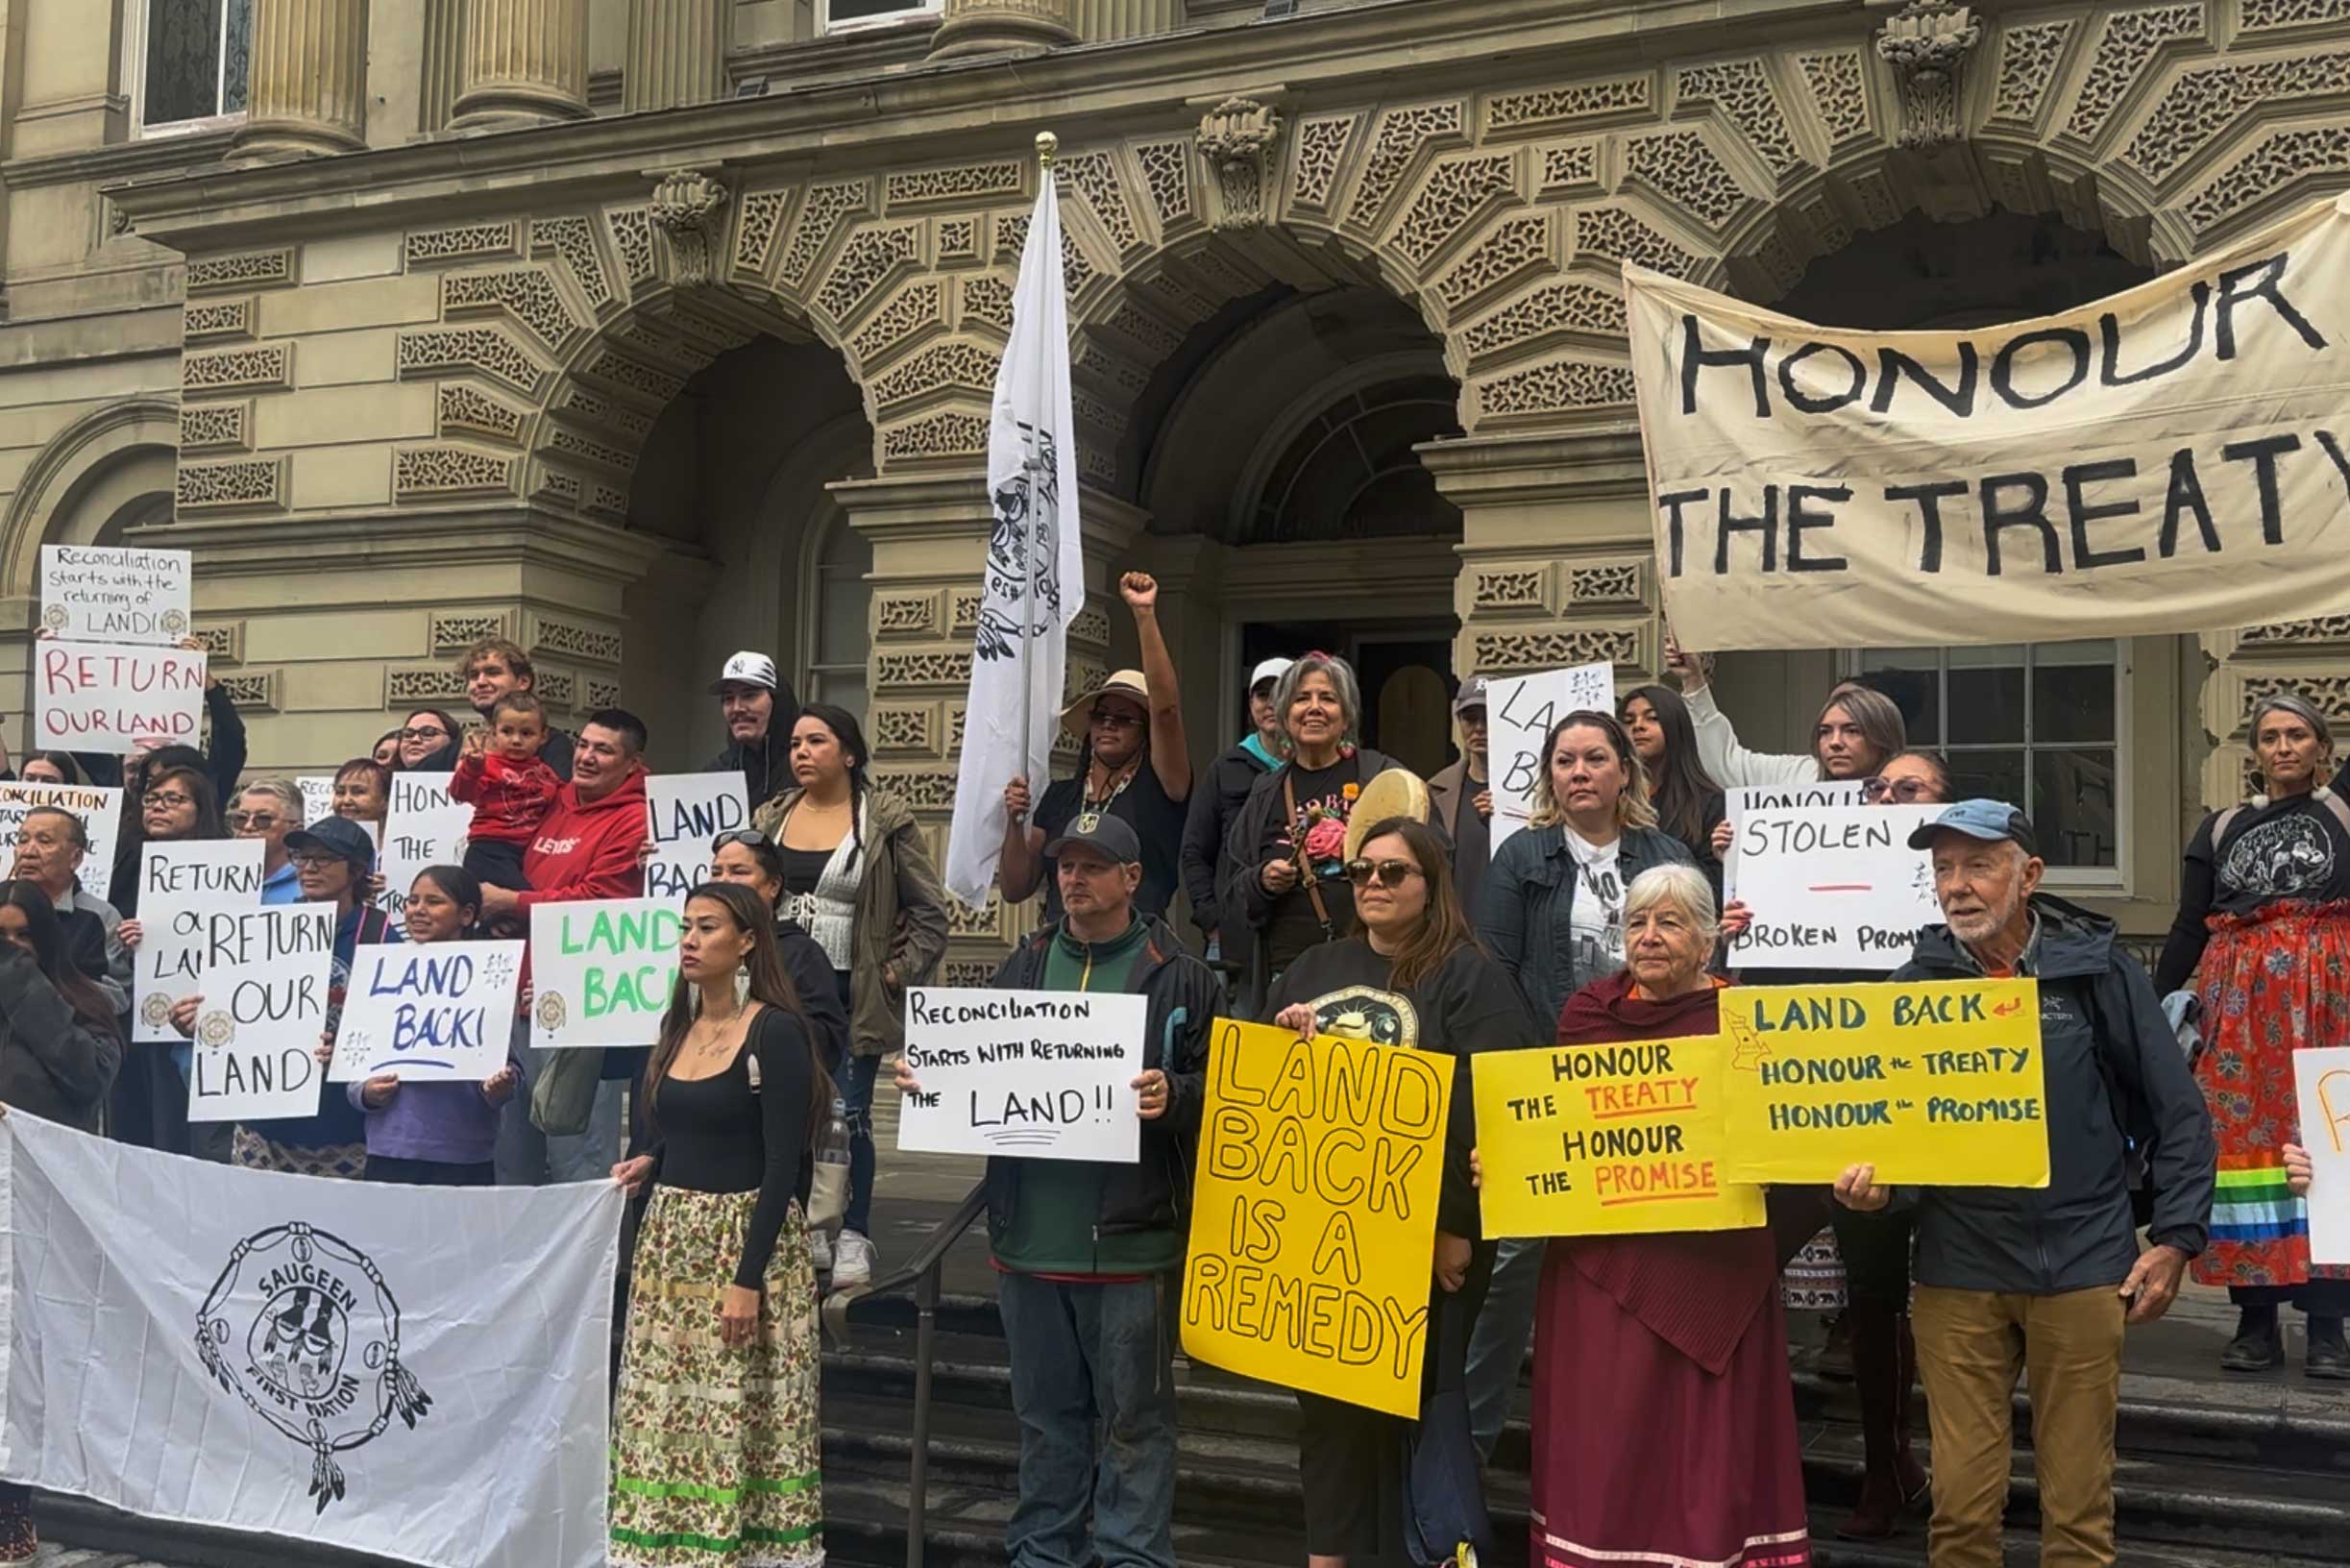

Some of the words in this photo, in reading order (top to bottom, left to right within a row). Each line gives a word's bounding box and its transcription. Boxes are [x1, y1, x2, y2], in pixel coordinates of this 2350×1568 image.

[1681, 252, 2330, 418] HONOUR
[1658, 482, 1853, 577] THE
[57, 547, 181, 574] Reconciliation
[63, 589, 132, 612] returning
[135, 592, 153, 605] of
[111, 571, 142, 587] with
[144, 574, 177, 591] the
[44, 649, 203, 696] RETURN
[45, 707, 110, 736] OUR
[116, 710, 194, 736] LAND
[1499, 679, 1554, 736] LA
[0, 788, 109, 810] ONCILIATION
[395, 779, 450, 814] HON
[649, 793, 743, 843] LAND
[1742, 820, 1892, 856] STOLEN
[392, 835, 436, 861] THE
[149, 854, 261, 894] RETURN
[648, 862, 709, 898] BAC
[208, 911, 333, 968] RETURN
[561, 910, 681, 956] LAND
[1736, 922, 1838, 951] BROKEN
[369, 954, 474, 998] LAND
[231, 974, 320, 1024] OUR
[909, 991, 1090, 1025] RECONCILIATION
[1754, 996, 1867, 1032] LAND
[1892, 992, 1987, 1026] BACK
[391, 1002, 485, 1051] BACK!
[197, 1048, 311, 1097] LAND
[907, 1043, 970, 1068] STARTS
[977, 1041, 1024, 1064] WITH
[1031, 1038, 1125, 1061] RETURNING
[1552, 1043, 1674, 1083] HONOUR
[1761, 1055, 1886, 1086] HONOUR
[1889, 1056, 1914, 1070] the
[1922, 1047, 2029, 1075] TREATY
[907, 1090, 942, 1109] THE
[1216, 1023, 1442, 1140] LAND
[1507, 1094, 1557, 1121] THE
[1584, 1077, 1700, 1112] TREATY
[1769, 1099, 1893, 1131] HONOUR
[1896, 1098, 1915, 1110] the
[1926, 1096, 2041, 1122] PROMISE
[1562, 1124, 1684, 1162] HONOUR
[1209, 1106, 1424, 1221] BACK
[1525, 1171, 1572, 1196] THE
[1594, 1161, 1717, 1196] PROMISE
[1230, 1194, 1285, 1263] IS
[1312, 1211, 1361, 1286] A
[257, 1262, 357, 1313] SAUGEEN
[1187, 1253, 1430, 1381] REMEDY
[245, 1365, 300, 1411] FIRST
[305, 1373, 360, 1419] NATION
